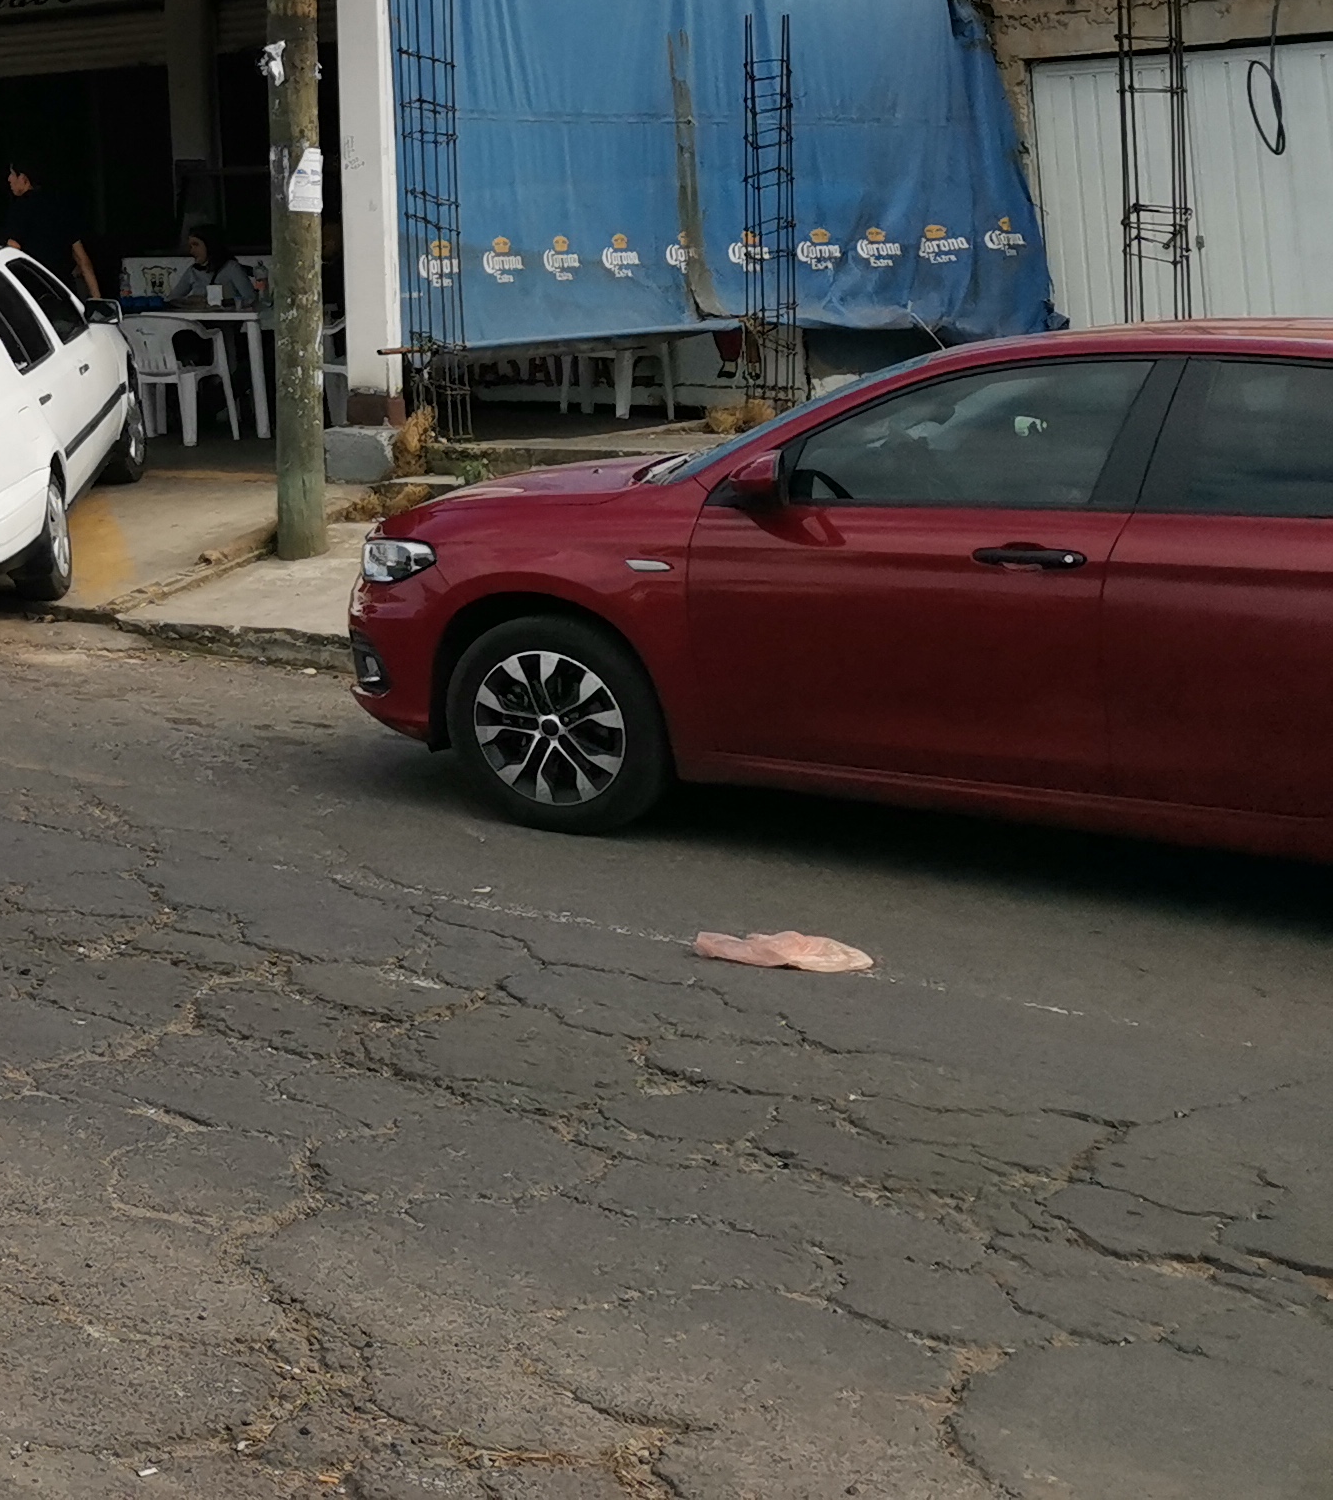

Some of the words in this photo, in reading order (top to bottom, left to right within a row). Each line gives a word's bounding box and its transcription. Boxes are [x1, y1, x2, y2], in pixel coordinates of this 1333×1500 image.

[602, 247, 640, 269] Corona
[797, 241, 841, 263] Corona
[857, 239, 902, 259] Corona
[929, 253, 958, 264] Extra
[484, 251, 524, 275] Corona
[544, 249, 582, 272] Corona
[870, 257, 893, 267] Extra
